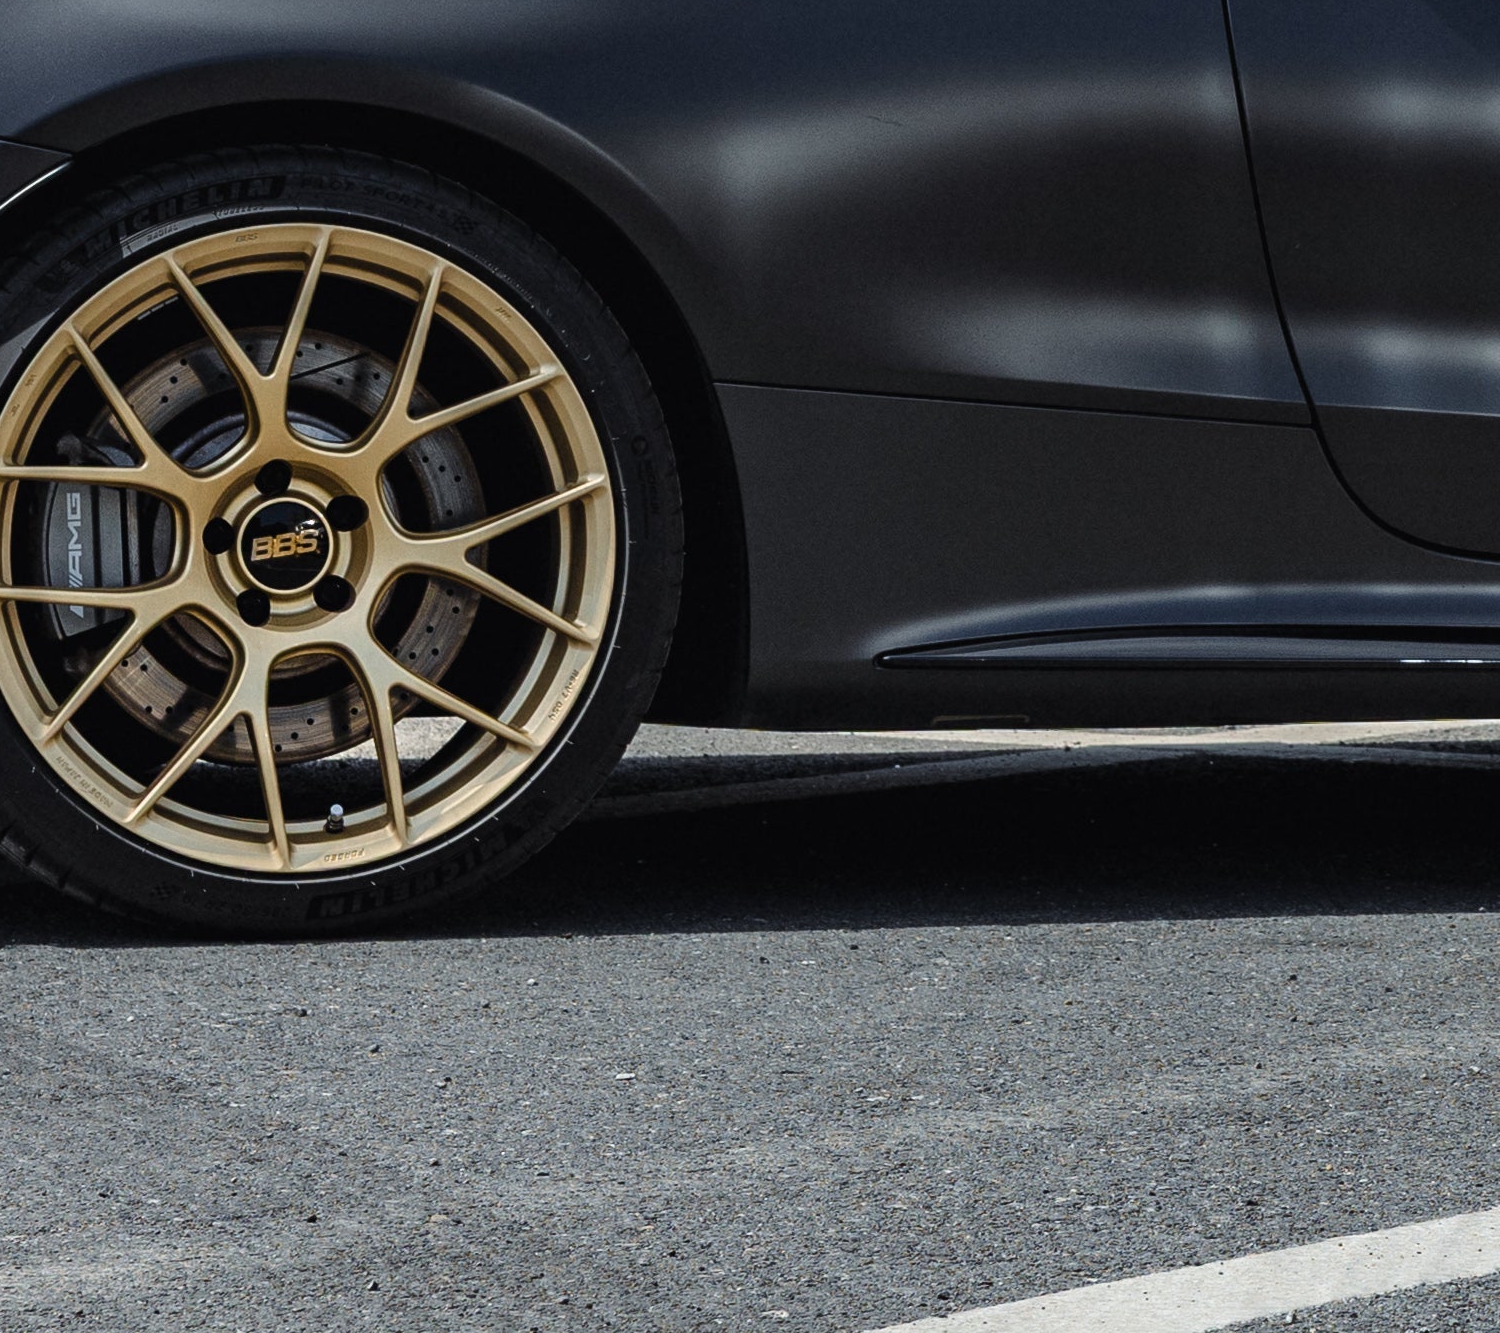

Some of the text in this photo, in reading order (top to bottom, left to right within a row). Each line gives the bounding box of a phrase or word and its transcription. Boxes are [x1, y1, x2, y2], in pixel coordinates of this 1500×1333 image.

[81, 177, 275, 258] MICHELIN
[66, 492, 83, 581] AMG
[251, 529, 320, 562] BBS
[314, 820, 524, 917] MICHELIN
